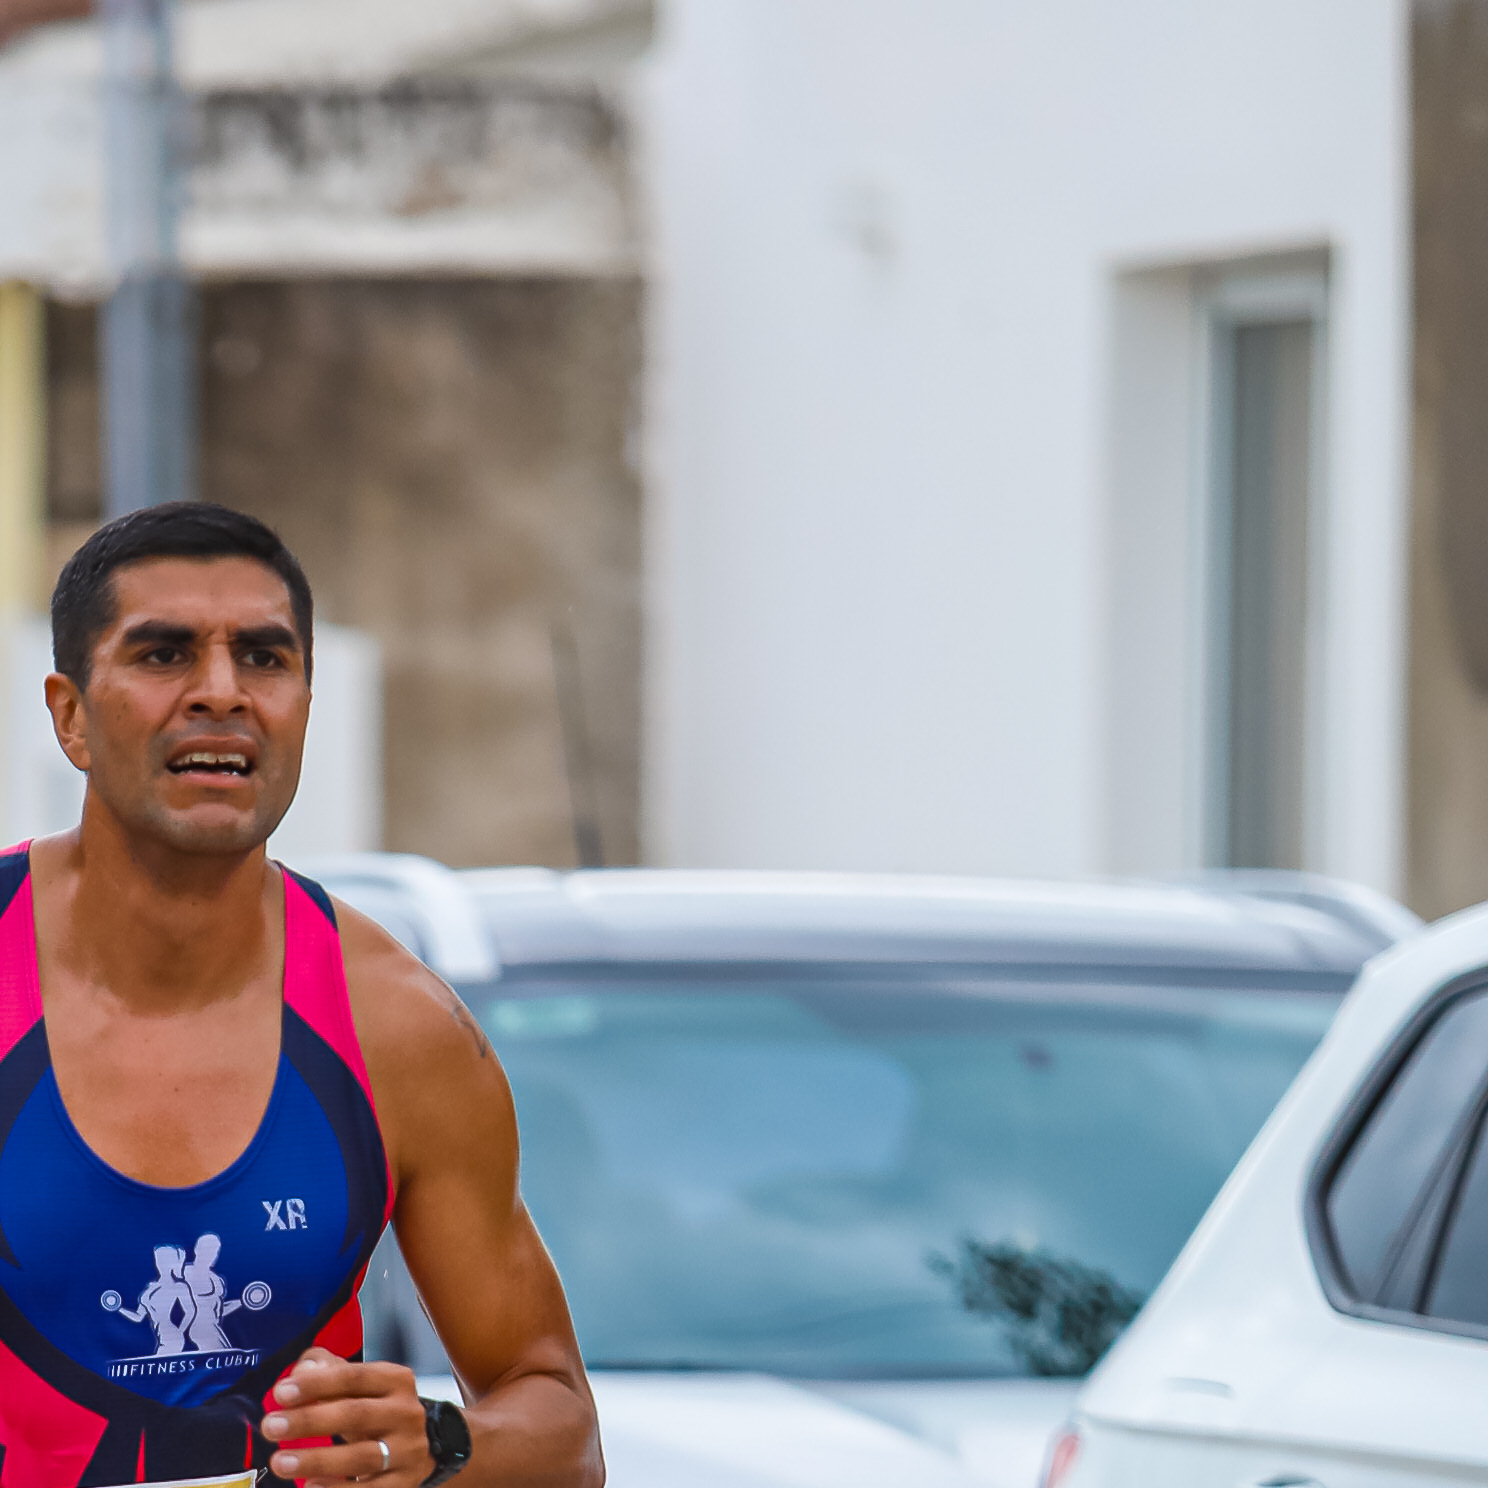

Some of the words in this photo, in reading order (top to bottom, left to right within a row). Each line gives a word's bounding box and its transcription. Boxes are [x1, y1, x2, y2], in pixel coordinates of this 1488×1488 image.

[262, 1198, 308, 1231] XR
[130, 1360, 195, 1376] FITNESS
[205, 1355, 242, 1369] CLUB
